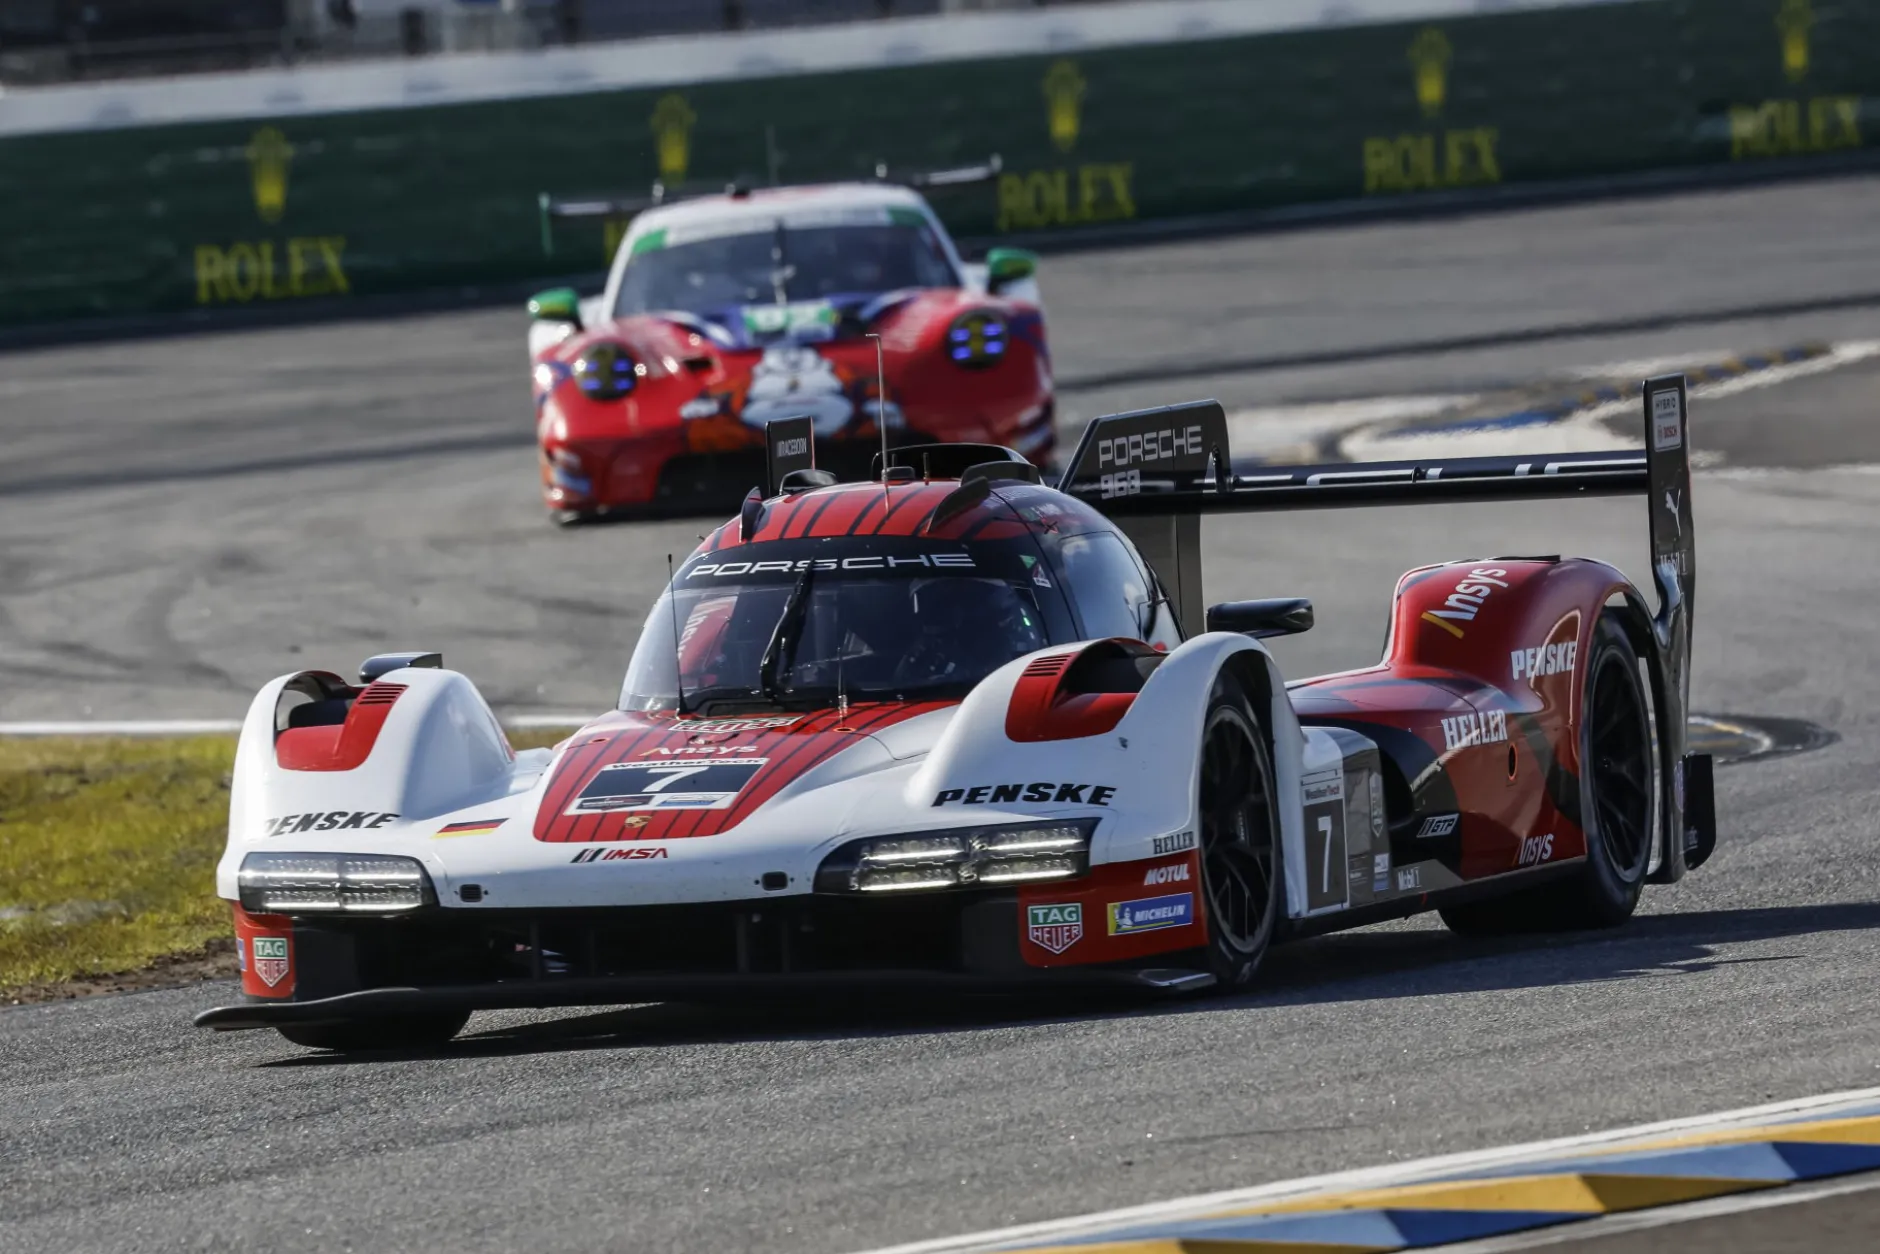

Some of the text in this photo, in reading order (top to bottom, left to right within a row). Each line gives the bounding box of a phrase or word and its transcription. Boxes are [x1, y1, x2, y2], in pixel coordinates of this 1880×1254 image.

[1731, 97, 1862, 160] ROLEX
[1363, 127, 1500, 192] ROLEX
[997, 163, 1136, 230] ROLEX
[195, 237, 349, 302] ROLEX
[1098, 425, 1202, 468] PORSCHE
[685, 553, 976, 580] PORSCHE
[1511, 641, 1577, 680] PENSKE
[1441, 709, 1507, 750] HELLER
[639, 746, 758, 756] Ansys
[641, 766, 710, 793] 7
[931, 783, 1117, 807] PENSKE
[1431, 818, 1454, 833] GTP
[601, 848, 668, 861] IMSA
[1153, 831, 1195, 854] HELLER
[1317, 815, 1332, 893] 7
[1144, 863, 1190, 886] MOTUL
[1033, 907, 1077, 924] TAG
[1134, 904, 1186, 922] MICHELIN
[255, 941, 283, 956] TAG
[1032, 925, 1079, 950] HEUER
